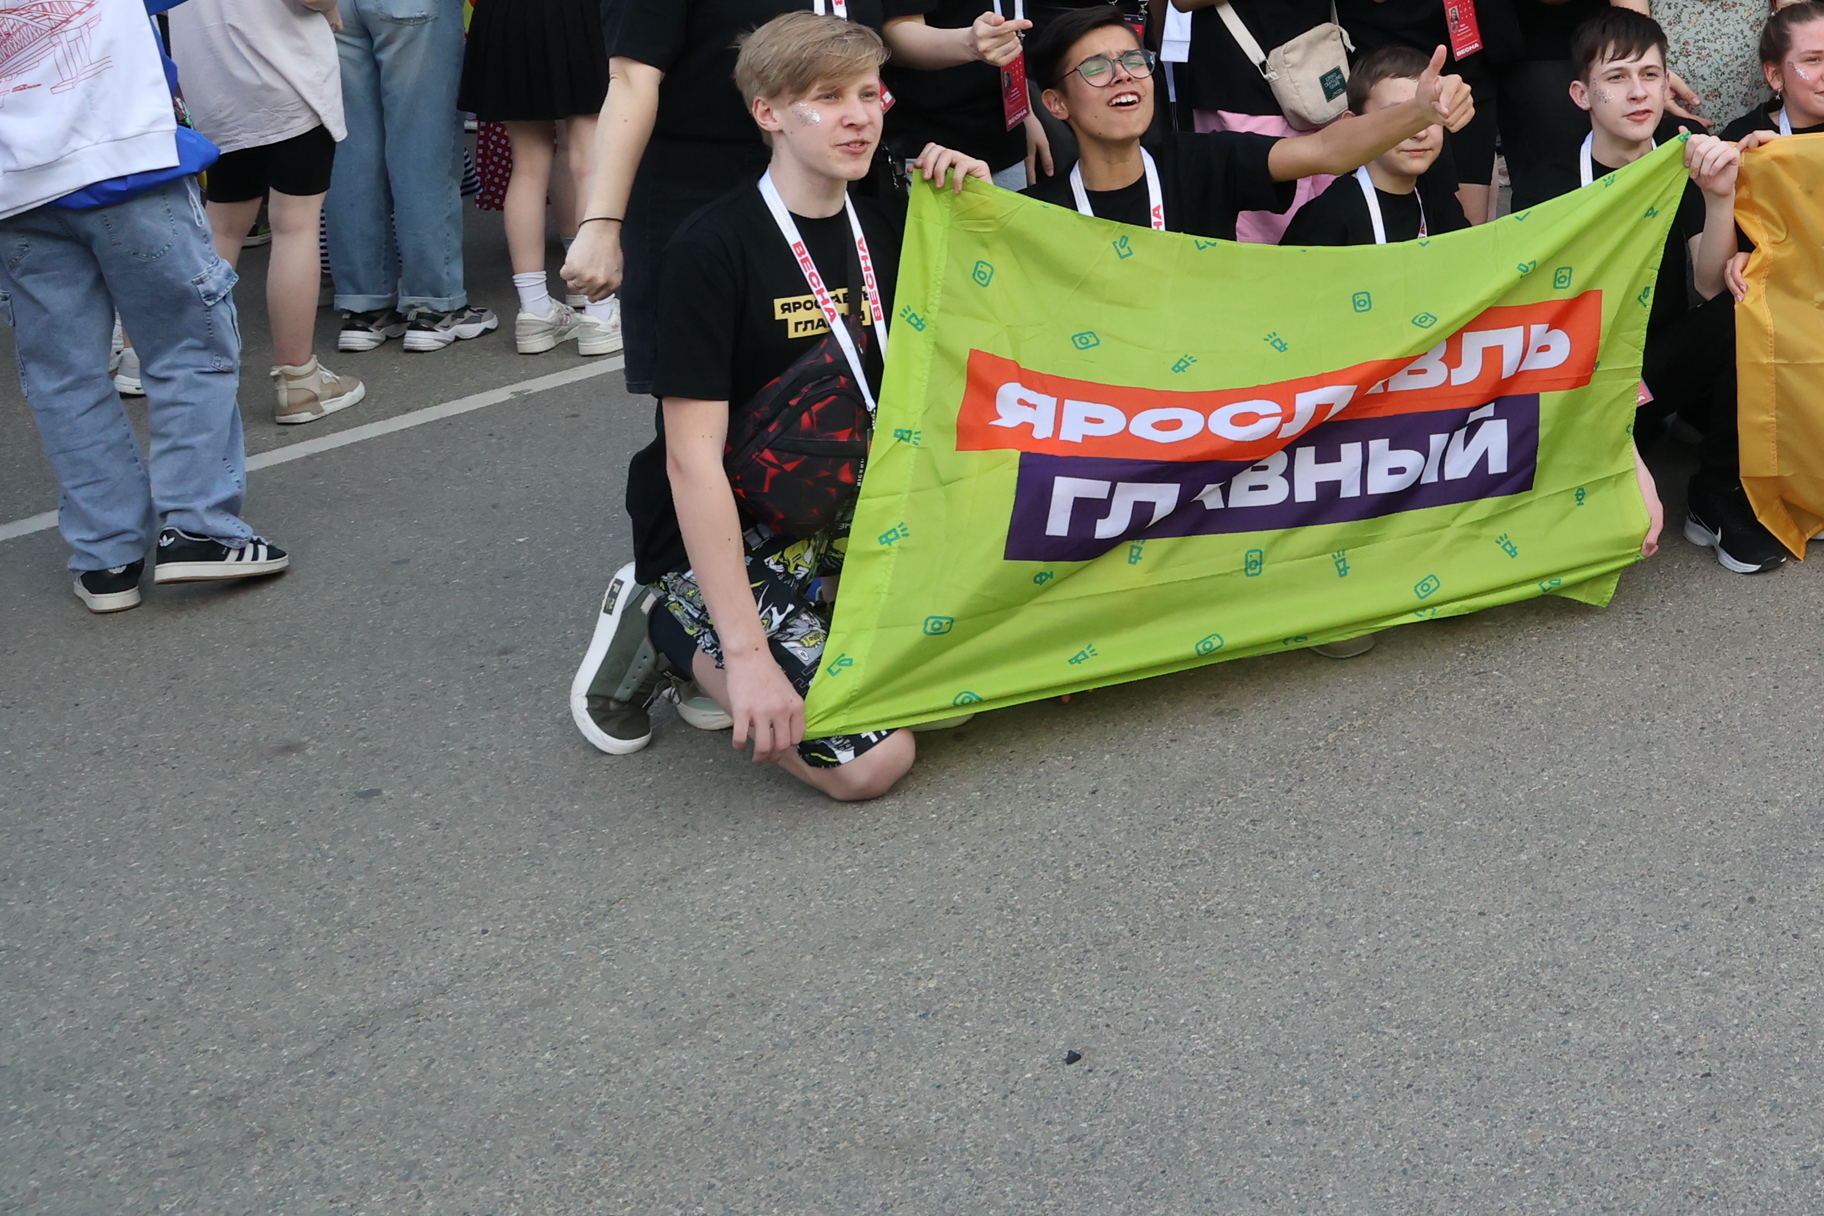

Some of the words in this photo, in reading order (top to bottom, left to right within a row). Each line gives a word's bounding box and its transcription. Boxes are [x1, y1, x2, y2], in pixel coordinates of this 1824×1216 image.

[1456, 42, 1479, 56] ВЕСНА
[792, 241, 837, 323] ВЕСНА
[857, 237, 882, 321] ВЕСНА
[988, 323, 1571, 443] ЯРОСЛВЛЬ
